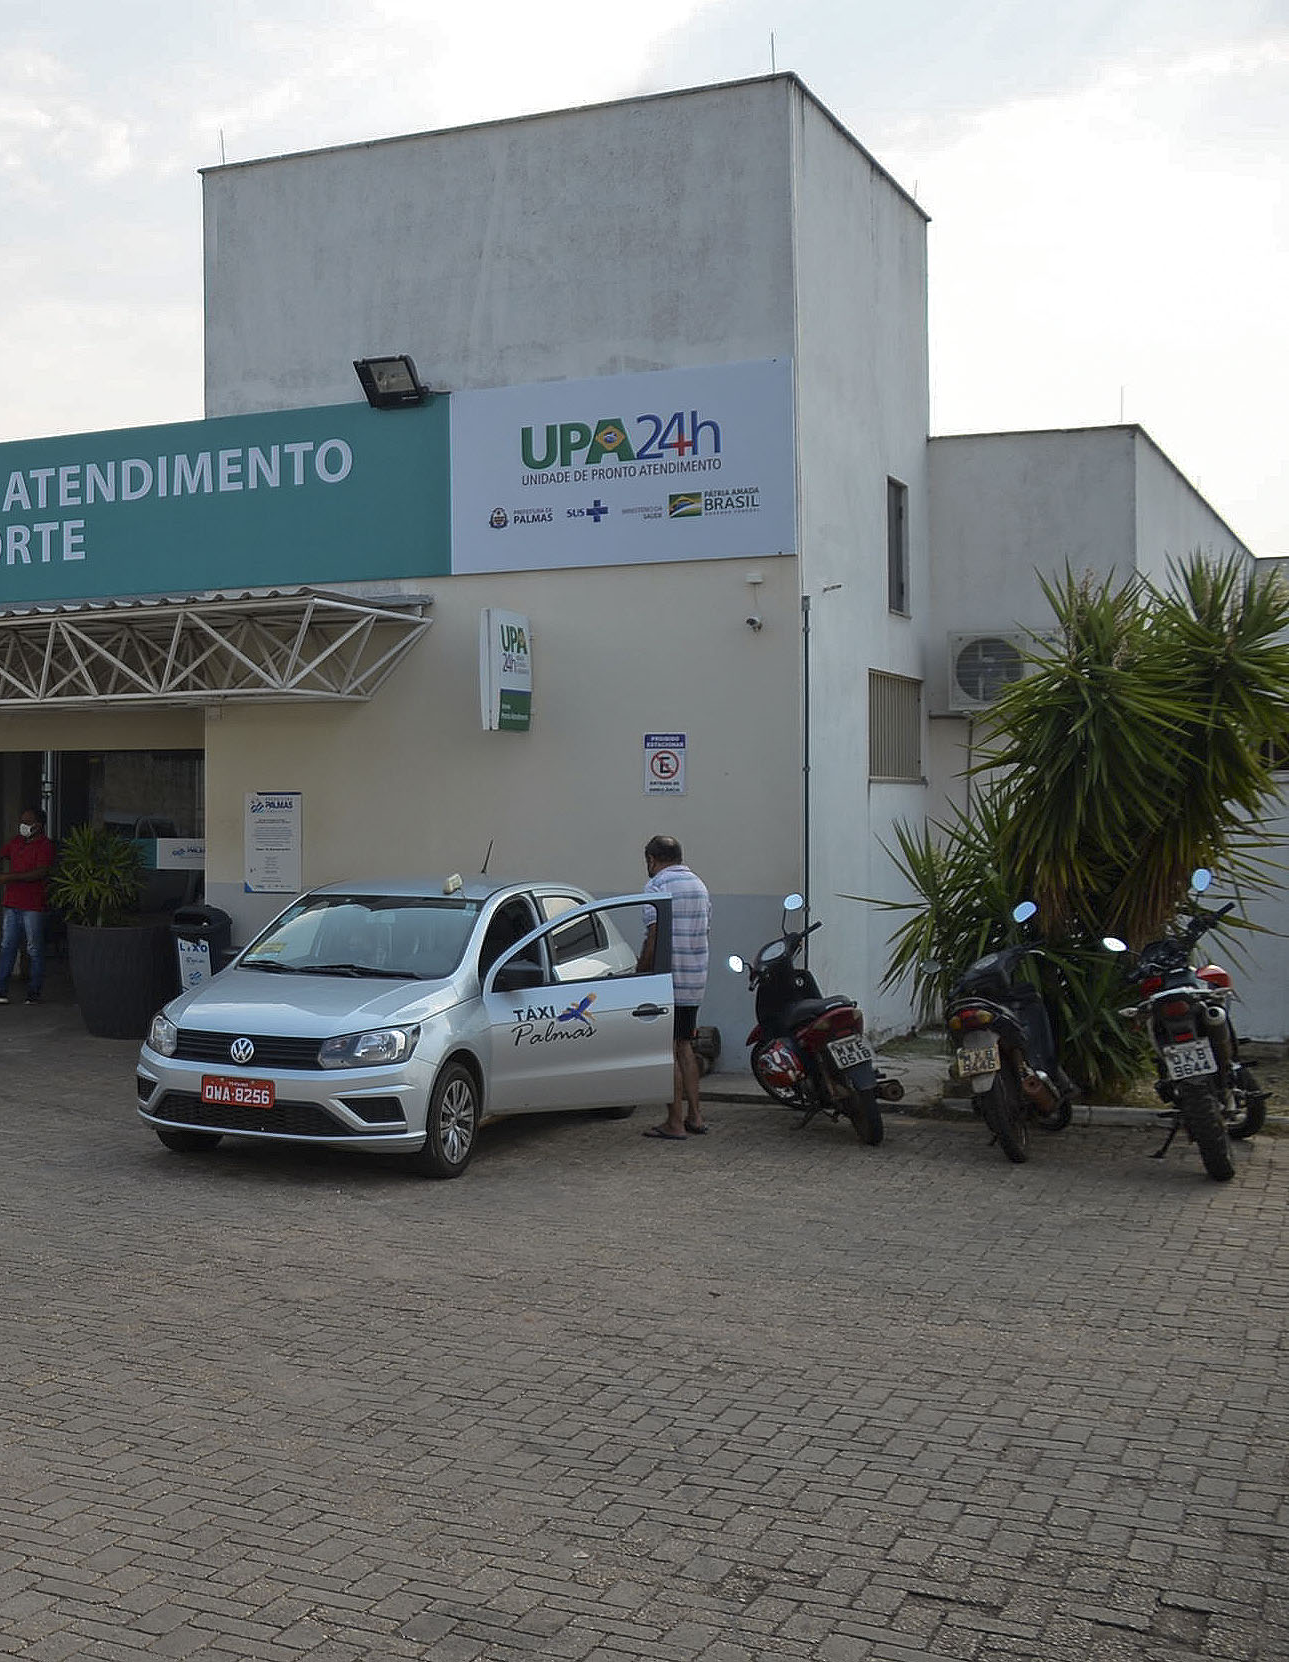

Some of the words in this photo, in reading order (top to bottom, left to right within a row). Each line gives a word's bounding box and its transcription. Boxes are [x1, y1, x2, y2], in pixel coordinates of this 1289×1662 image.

[1, 438, 353, 512] ATENDIMENTO
[522, 468, 570, 485] UNIDADE
[574, 467, 588, 481] DE
[591, 462, 637, 480] PRONTO
[639, 457, 722, 477] ATENDIMENTO
[567, 508, 586, 517] SUS
[704, 495, 760, 511] BRASIL
[513, 513, 554, 524] PALMAS
[501, 624, 528, 655] UPA
[511, 1021, 597, 1046] Palmas
